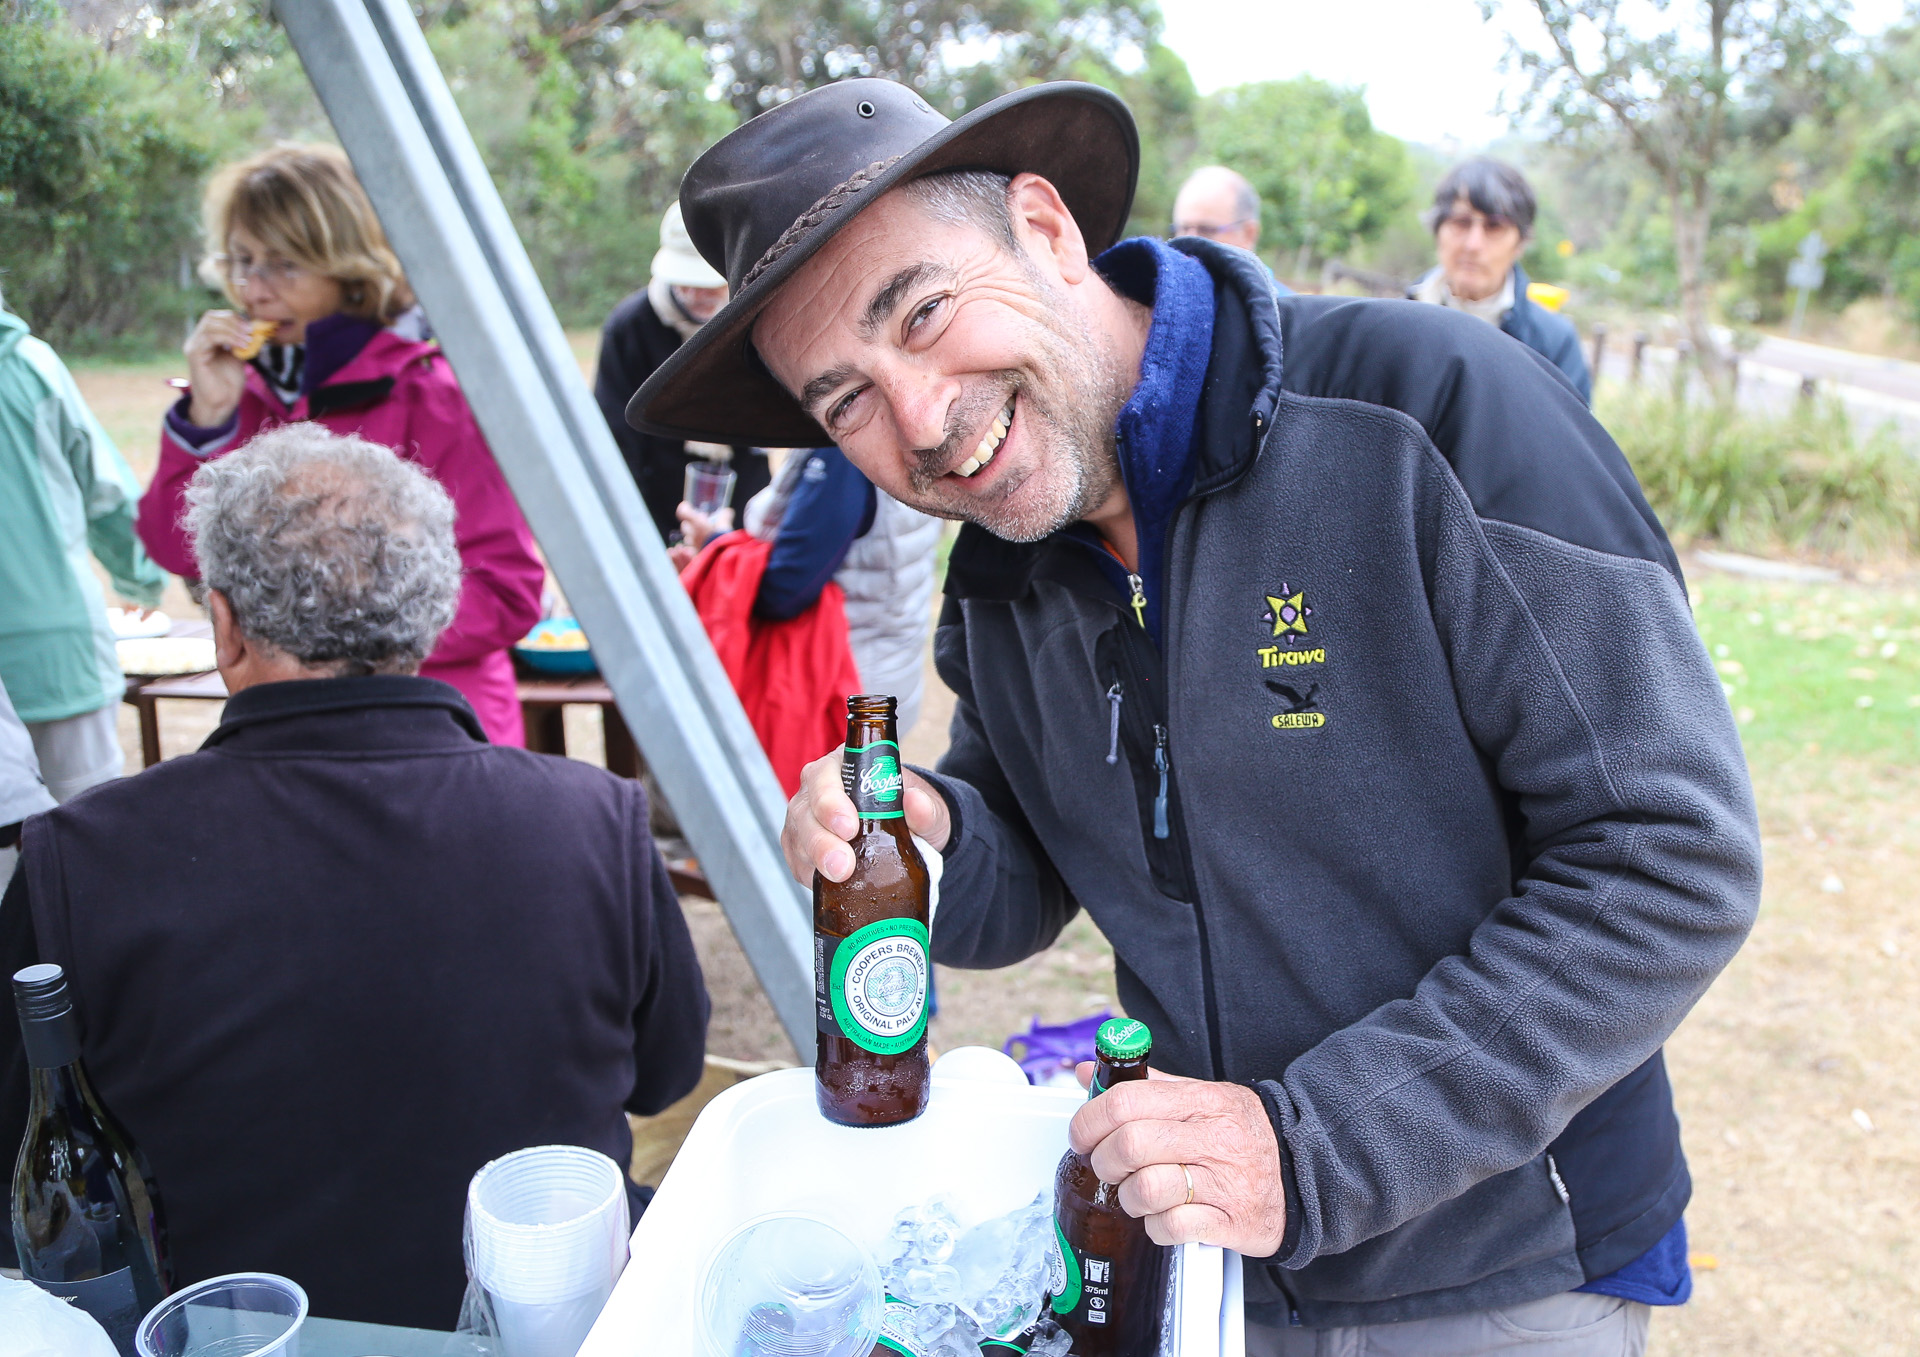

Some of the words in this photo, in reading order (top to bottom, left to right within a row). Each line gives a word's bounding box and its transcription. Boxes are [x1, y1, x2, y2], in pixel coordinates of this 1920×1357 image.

[1257, 645, 1325, 668] Tirawa
[1277, 715, 1319, 727] SALEWA
[860, 763, 902, 797] Coopers
[847, 942, 856, 951] NO
[855, 927, 885, 944] ADDITIVES
[852, 944, 893, 984] COOPERS
[896, 943, 925, 976] BREWERY
[852, 995, 893, 1029] ORIGINAL
[896, 1010, 916, 1028] PALE
[916, 989, 924, 1009] ALE
[843, 1017, 872, 1045] AUSTRALIAN
[873, 1041, 890, 1049] MADE
[1102, 1021, 1144, 1046] Coopers
[1084, 1284, 1109, 1296] 375ml
